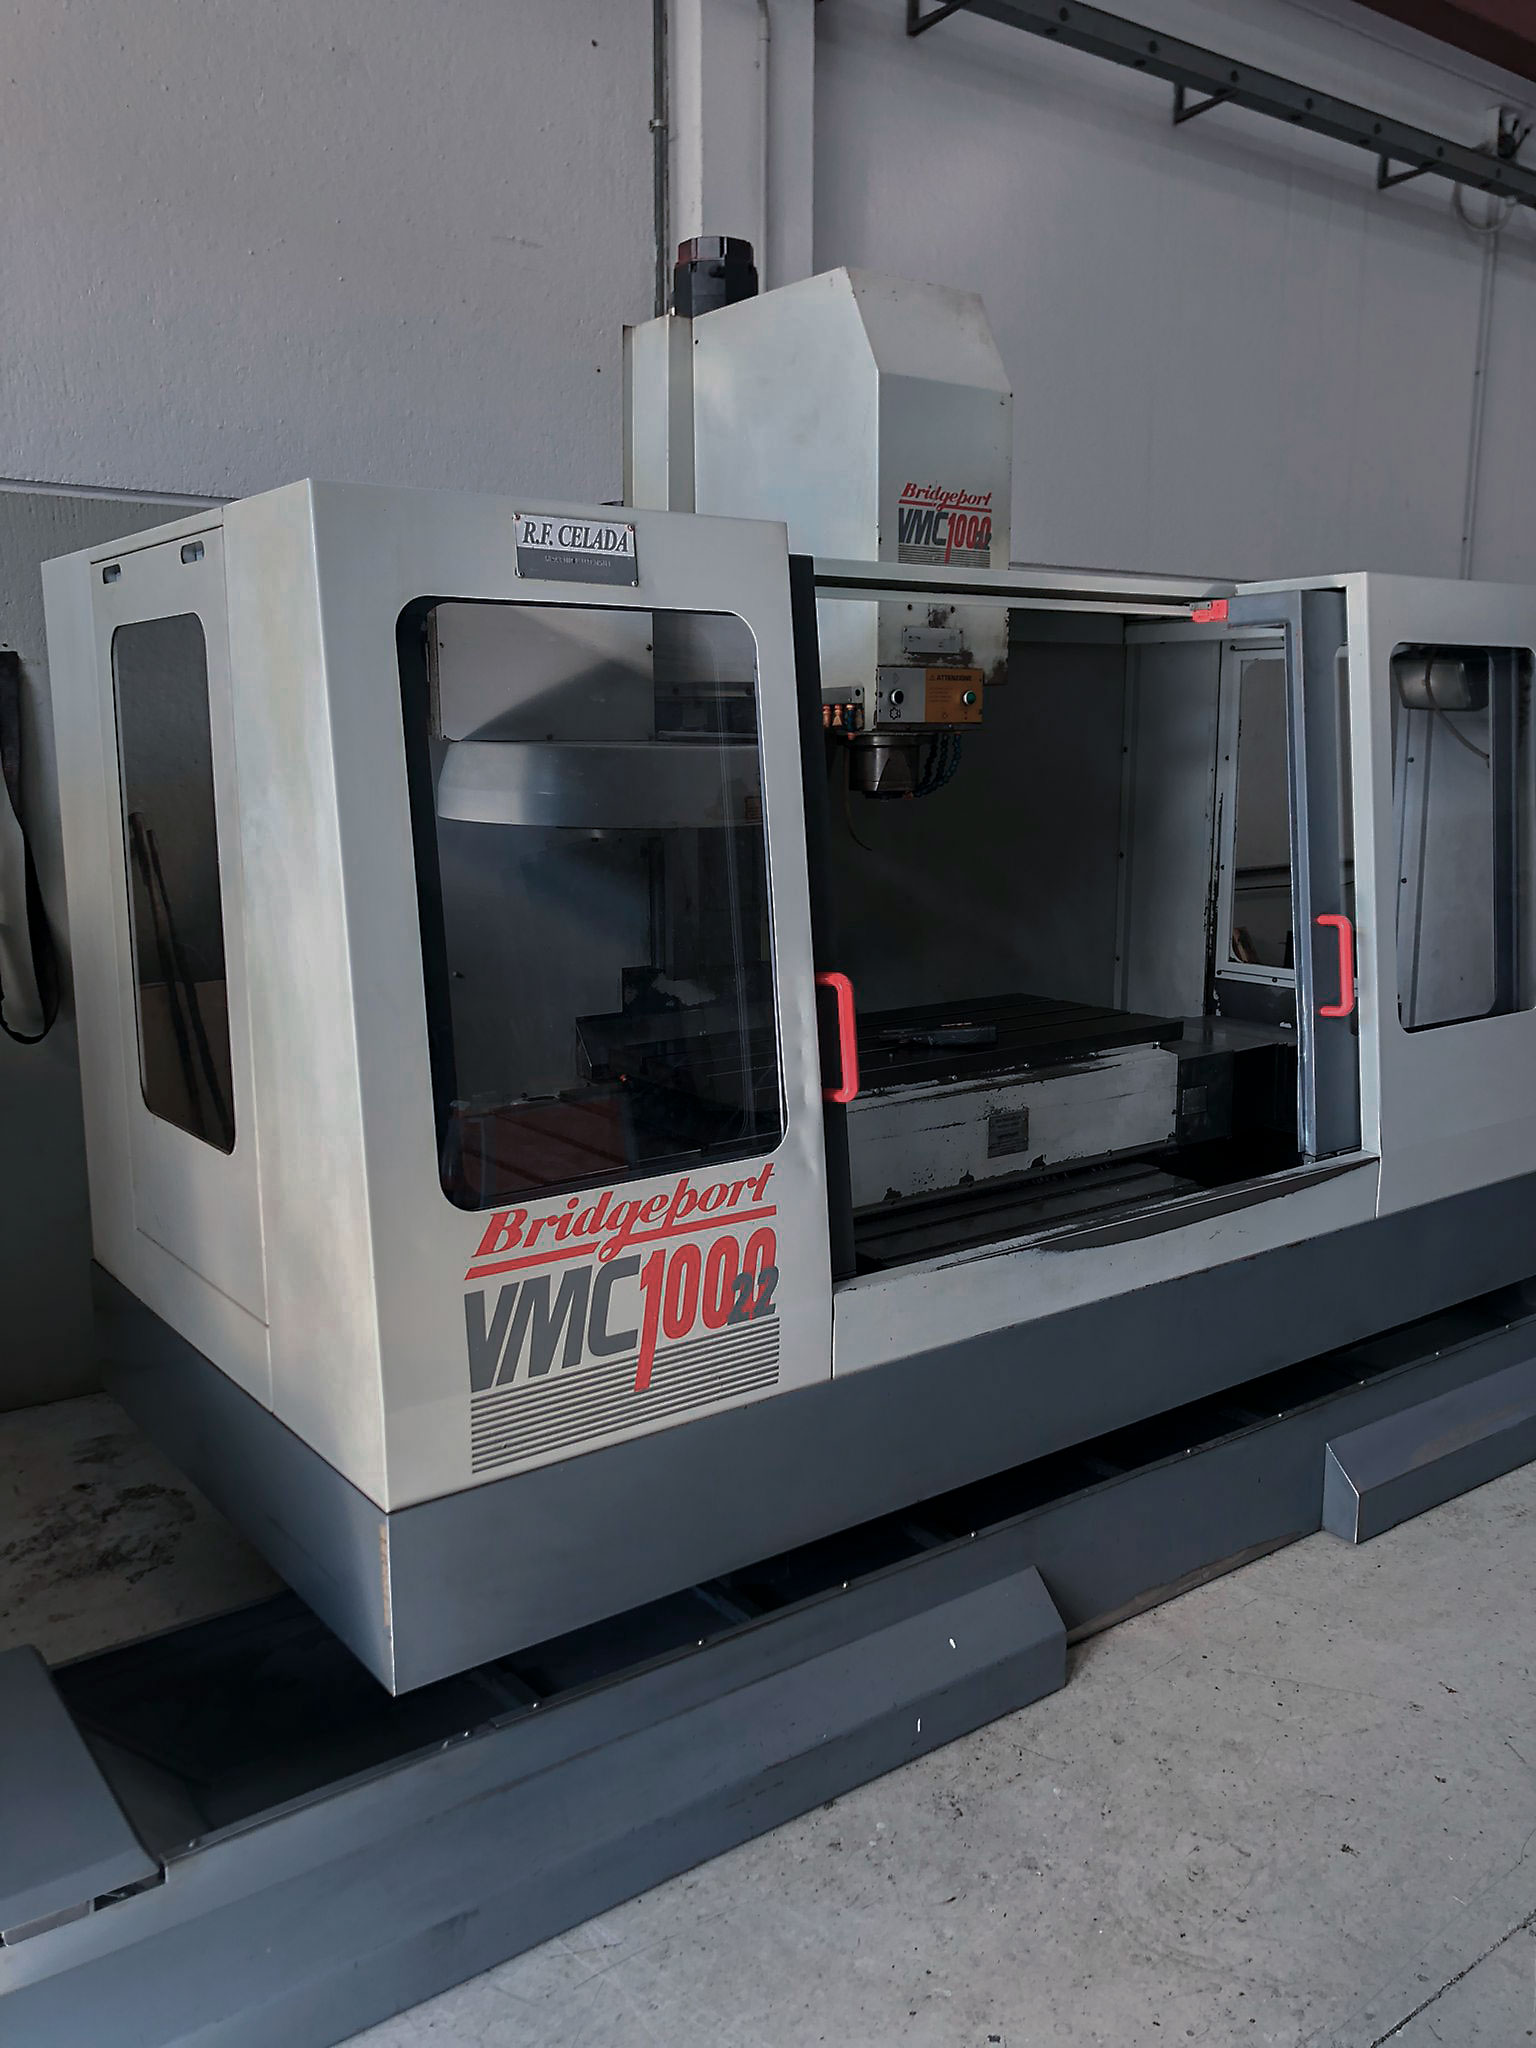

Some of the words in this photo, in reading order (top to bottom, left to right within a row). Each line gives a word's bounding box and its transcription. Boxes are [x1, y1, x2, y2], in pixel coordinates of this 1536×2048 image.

[901, 482, 992, 511] Bridgeport
[523, 521, 553, 546] R.F.
[558, 525, 628, 552] CELADA
[470, 1163, 776, 1263] Bridgeport
